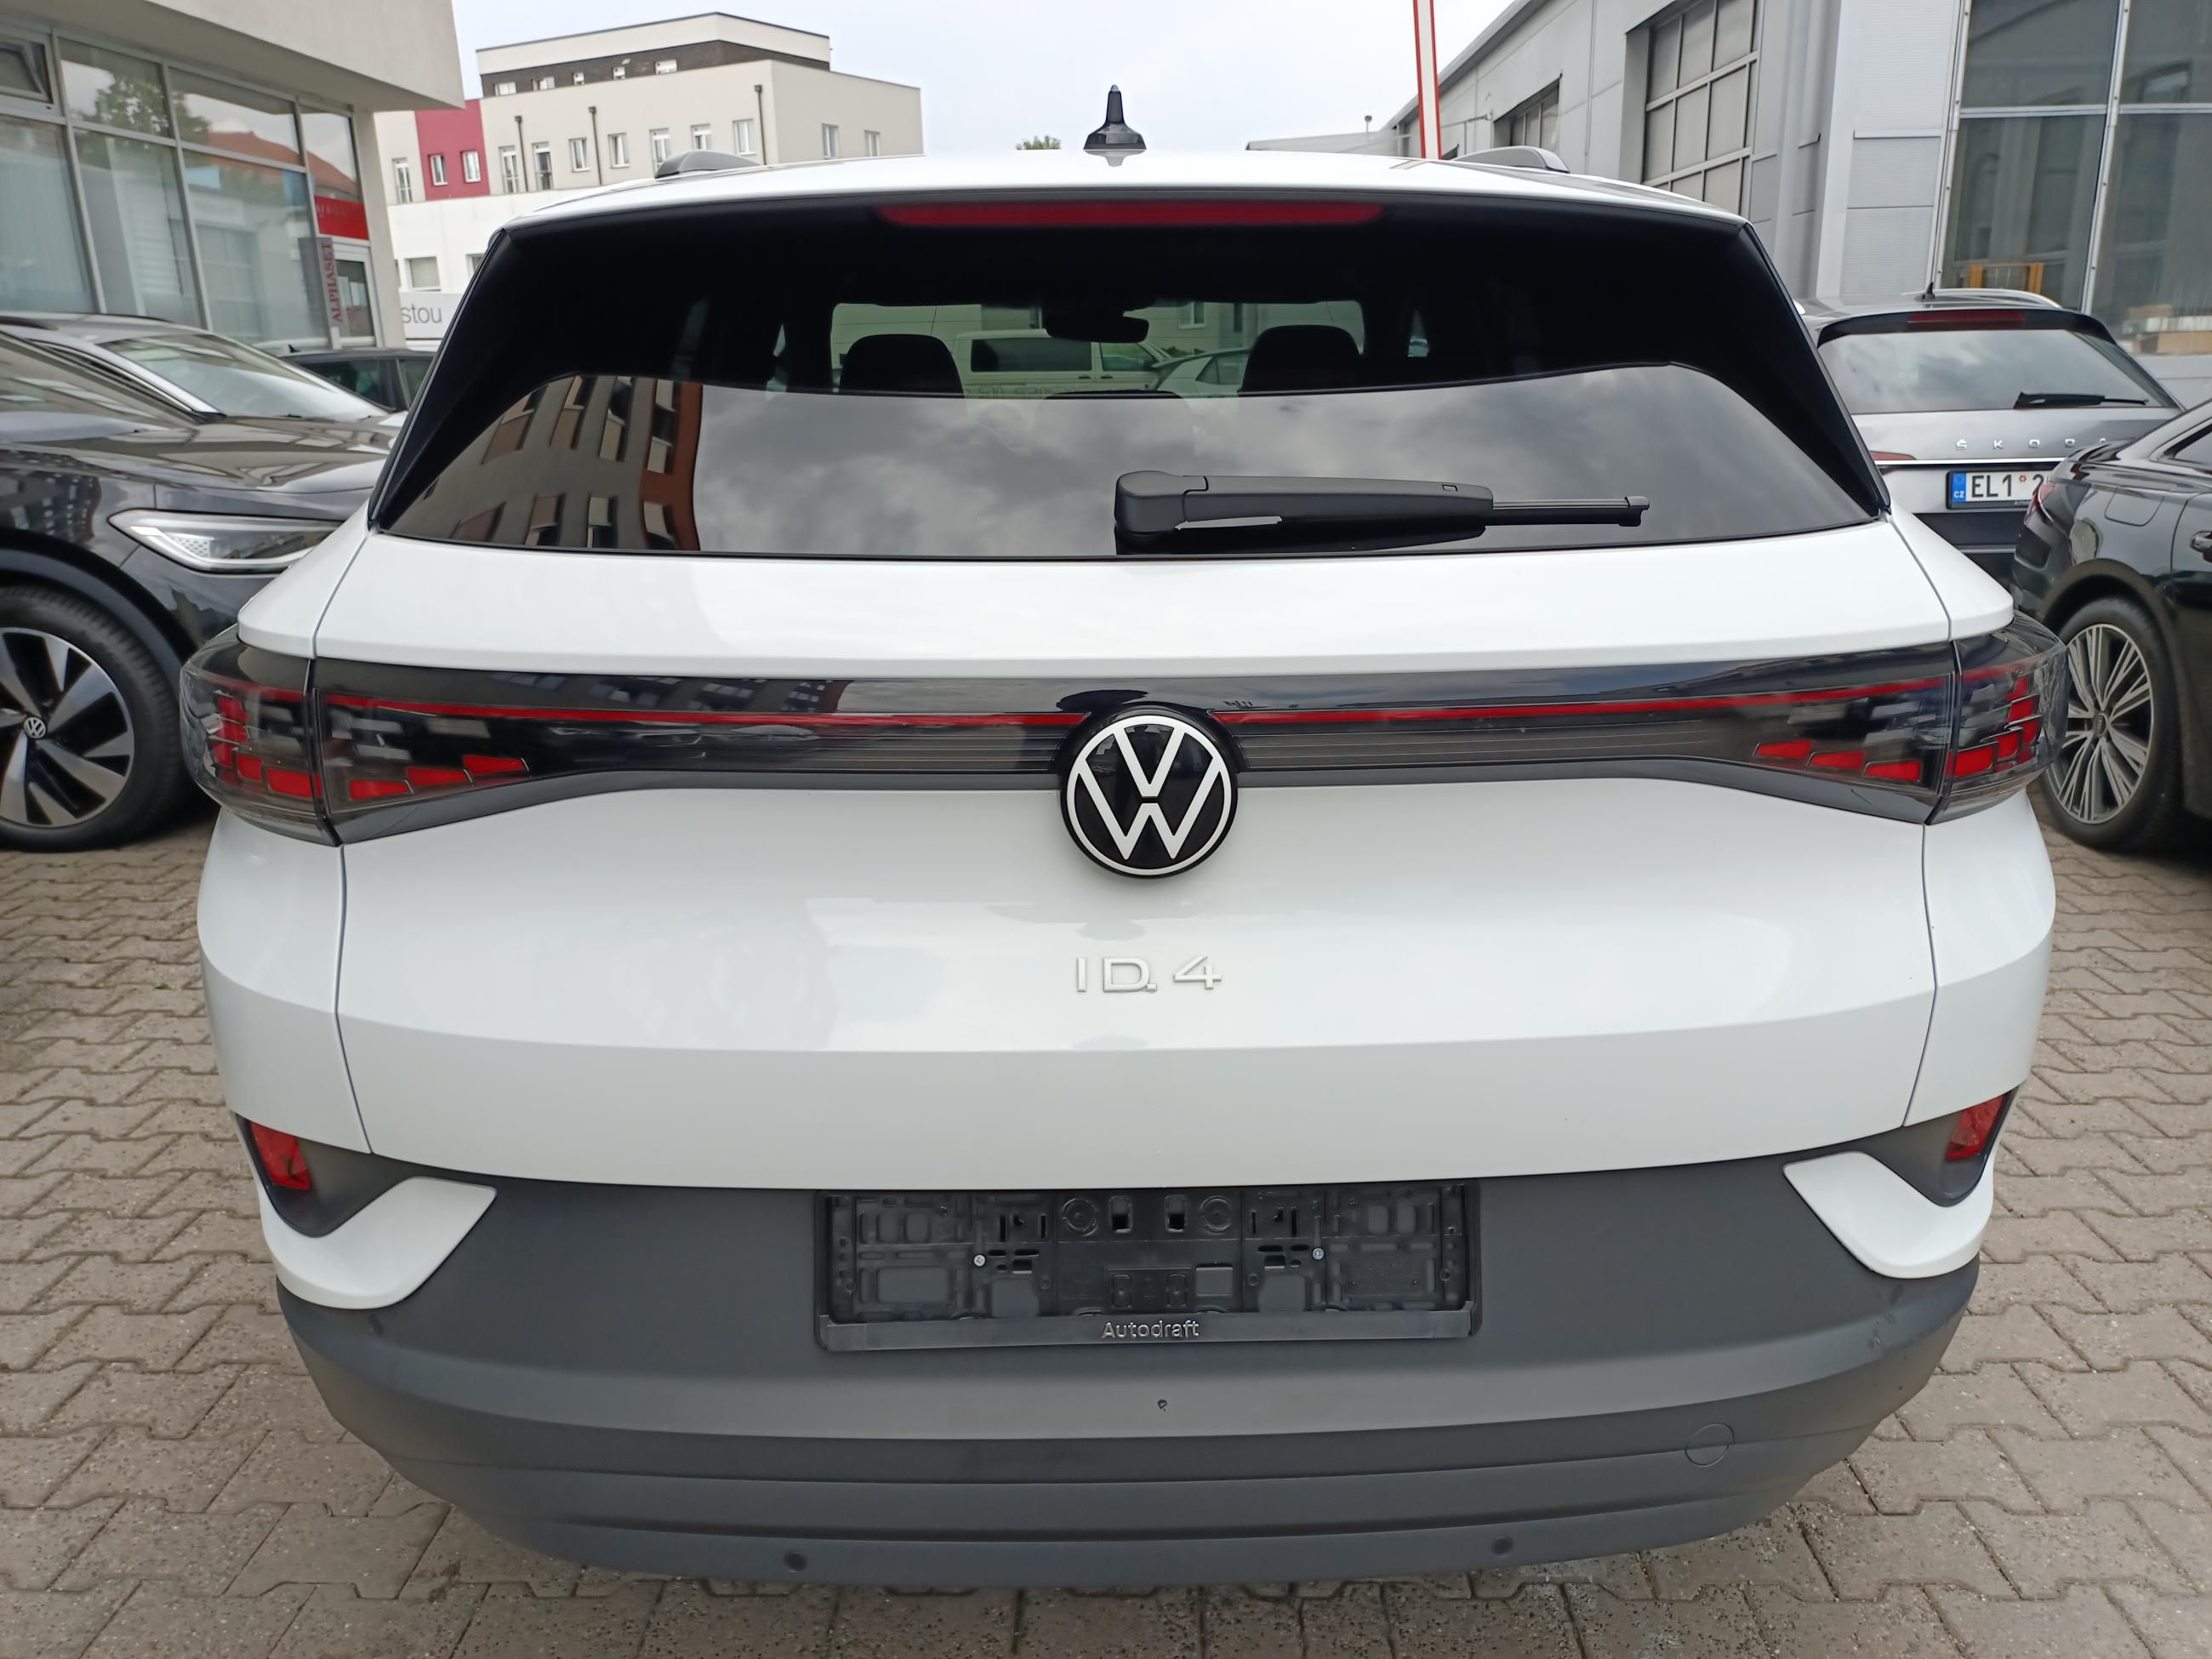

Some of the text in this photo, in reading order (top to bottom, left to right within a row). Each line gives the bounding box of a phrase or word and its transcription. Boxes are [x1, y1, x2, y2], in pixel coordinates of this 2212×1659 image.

[321, 242, 342, 322] ALPHASET
[1953, 474, 2050, 499] CZ EL1 2
[1102, 1320, 1200, 1338] Autodraft
